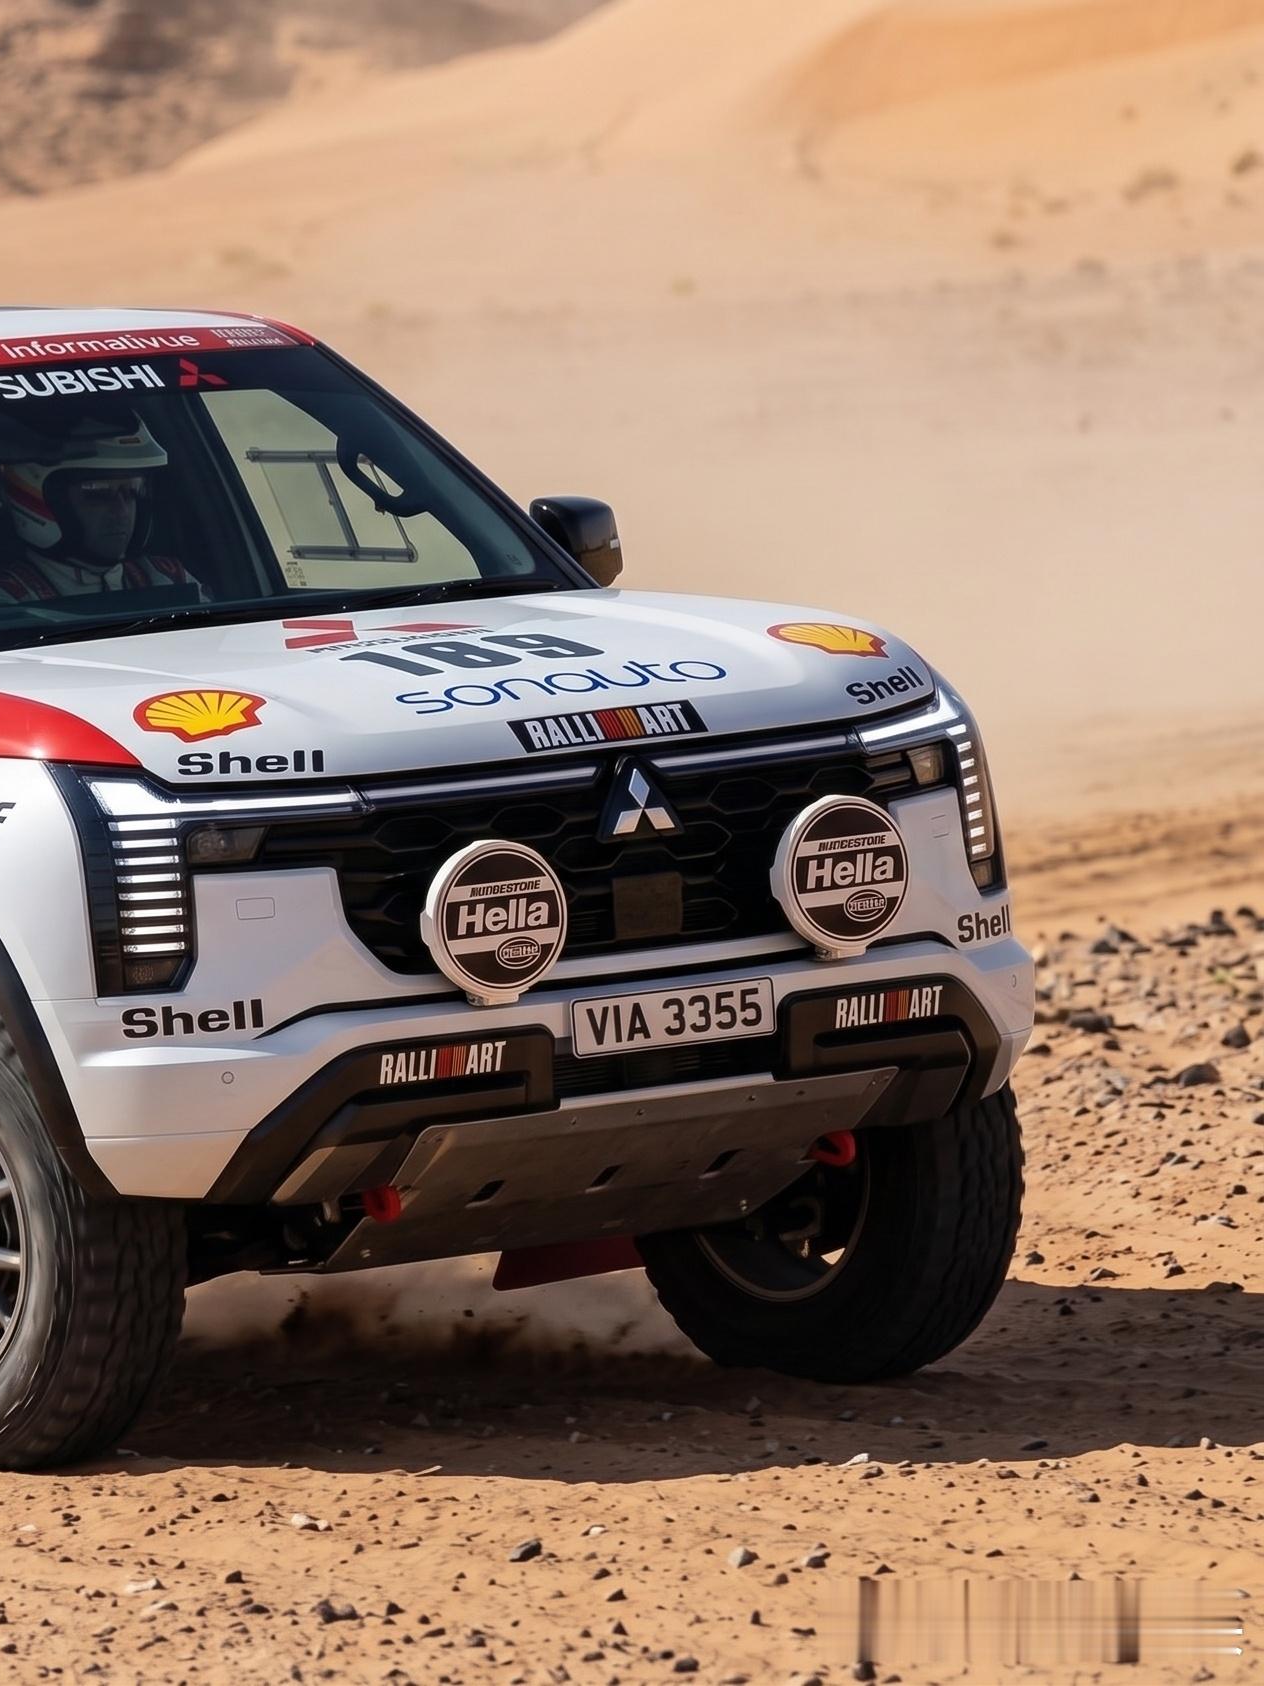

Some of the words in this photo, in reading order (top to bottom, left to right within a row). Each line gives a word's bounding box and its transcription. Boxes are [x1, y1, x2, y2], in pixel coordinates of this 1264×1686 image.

[339, 633, 604, 677] 189
[396, 660, 727, 715] sonauto
[846, 665, 924, 705] Shell
[177, 749, 324, 776] Shell
[806, 852, 895, 890] Hella
[457, 897, 549, 936] Hella
[957, 903, 1011, 943] Shell
[121, 999, 264, 1039] Shell
[585, 1002, 651, 1045] VIA
[662, 987, 763, 1037] 3355
